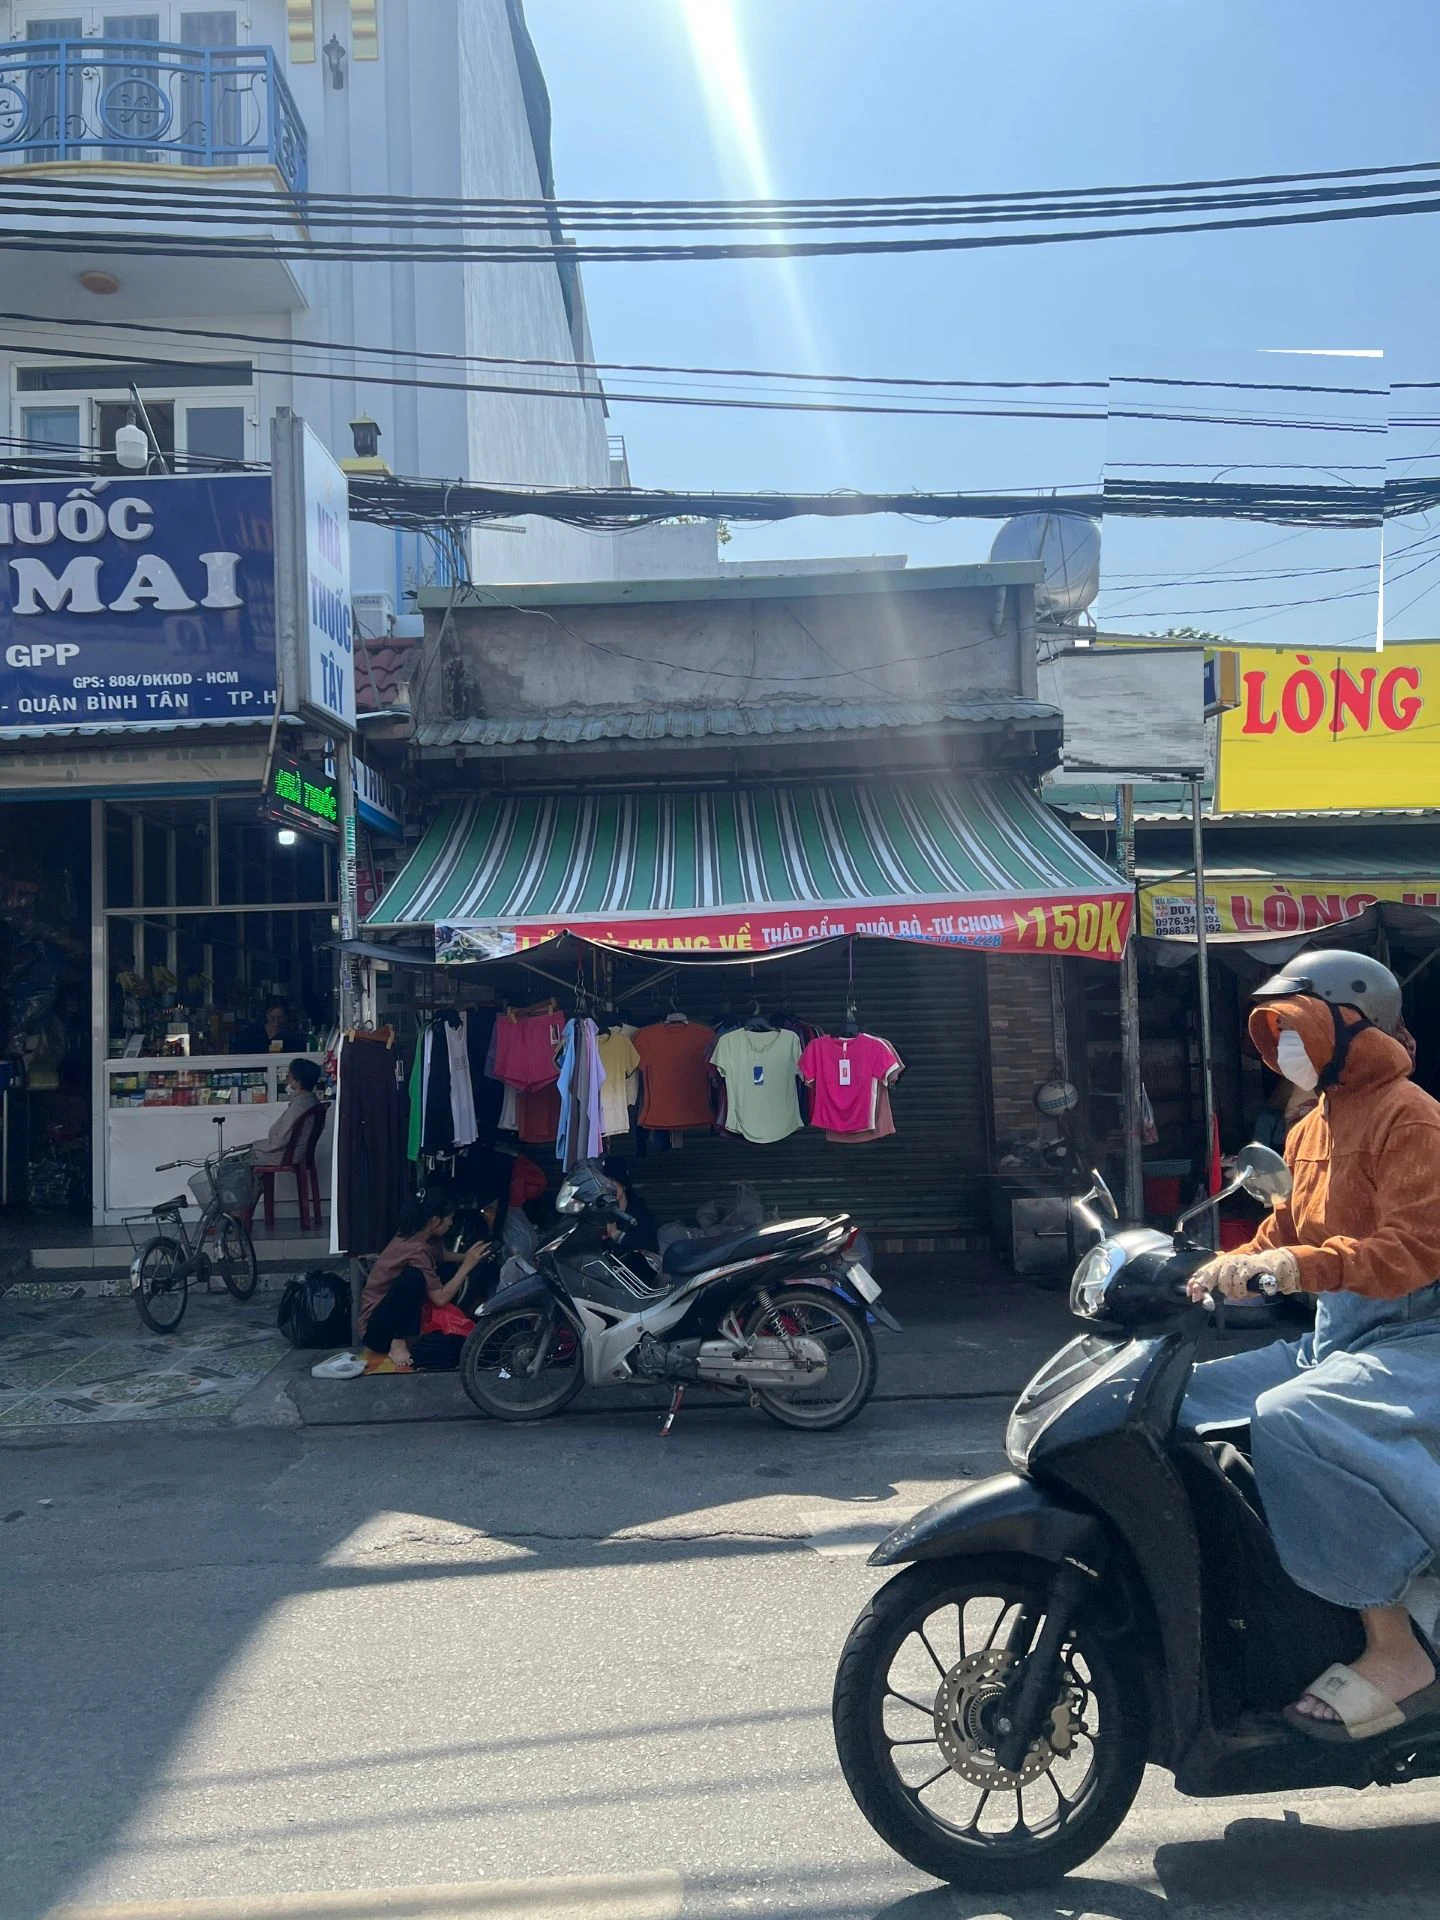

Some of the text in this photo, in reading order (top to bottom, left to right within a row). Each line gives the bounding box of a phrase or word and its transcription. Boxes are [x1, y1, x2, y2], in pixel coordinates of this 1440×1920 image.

[9, 551, 245, 615] MAI
[310, 572, 351, 654] THUỐC
[5, 643, 80, 668] GPP
[73, 676, 105, 689] GPS:
[108, 673, 193, 687] 808/ĐKKDD
[206, 671, 239, 684] HCM
[321, 650, 344, 715] TÂY
[18, 694, 77, 715] QUẬN
[87, 692, 138, 710] BÌNH
[146, 690, 189, 709] TÂN
[1241, 654, 1423, 734] LÒNG
[1027, 900, 1125, 953] 150K
